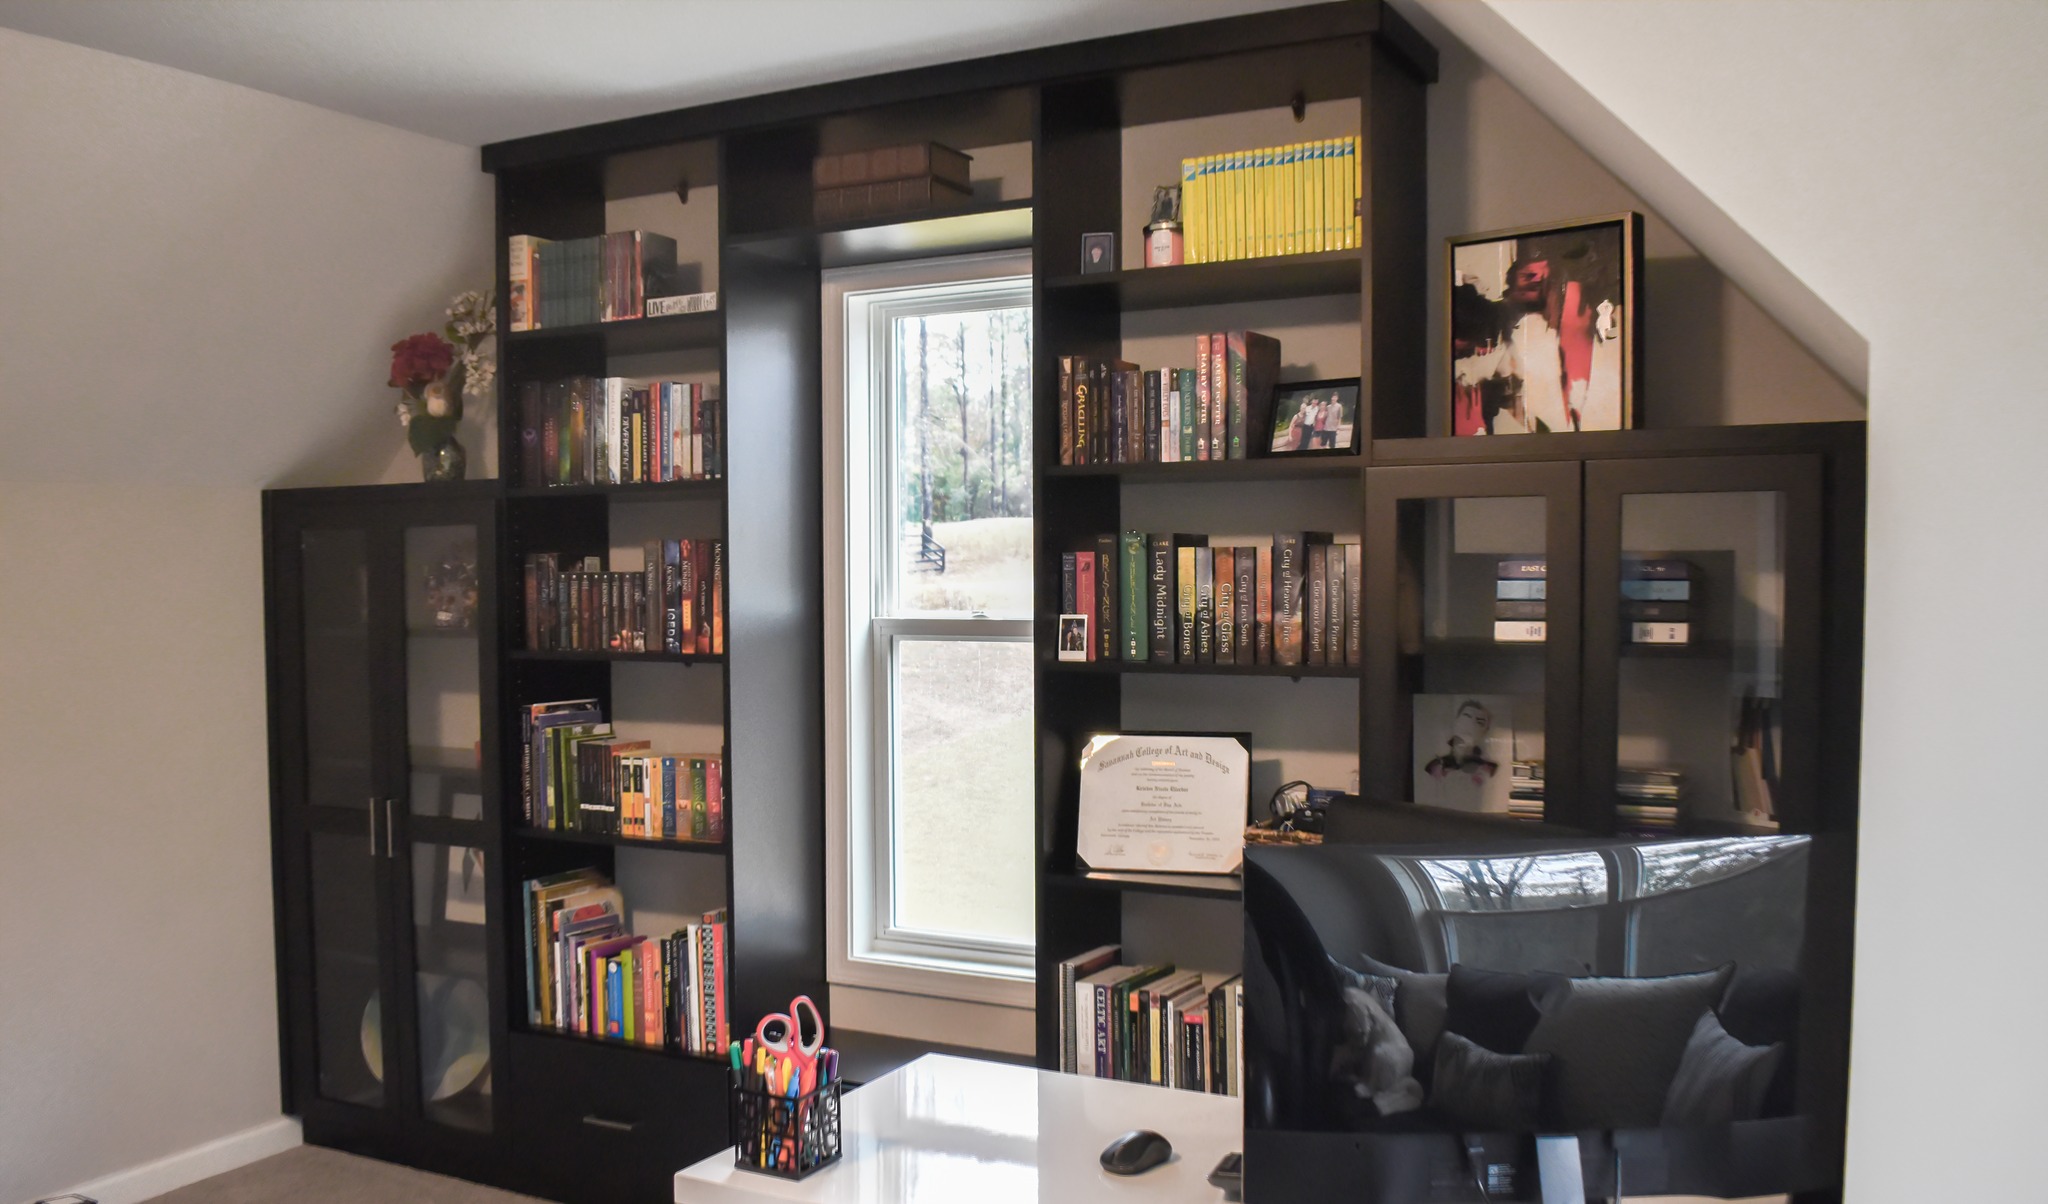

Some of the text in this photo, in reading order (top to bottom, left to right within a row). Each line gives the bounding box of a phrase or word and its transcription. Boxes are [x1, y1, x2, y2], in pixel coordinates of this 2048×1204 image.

[648, 300, 665, 315] LIVE
[1076, 384, 1088, 448] GRACELING
[622, 416, 630, 471] DIVERGENT
[713, 543, 722, 580] MONING
[1281, 549, 1292, 569] City
[1102, 554, 1110, 623] BRISINGR
[1153, 551, 1167, 640] Lady Midnight
[1181, 584, 1193, 608] City
[1199, 584, 1209, 608] City
[1219, 583, 1232, 608] City
[1239, 574, 1249, 596] City
[1241, 604, 1249, 622] Lost
[1281, 580, 1292, 623] Heavenly
[1312, 580, 1322, 652] Clockwork Angel
[1331, 579, 1340, 651] Clockwork Prince
[1351, 577, 1360, 651] Clockwork Princess
[666, 608, 676, 637] ICED
[1200, 621, 1210, 653] Ashes
[1221, 622, 1232, 653] Glass
[1241, 623, 1249, 647] Souls
[1259, 622, 1269, 649] Angels
[1283, 625, 1292, 643] Fire
[1183, 622, 1193, 656] Bones
[1097, 745, 1230, 775] Savannah College of Art and Design
[1096, 987, 1107, 1054] CELTIC ART
